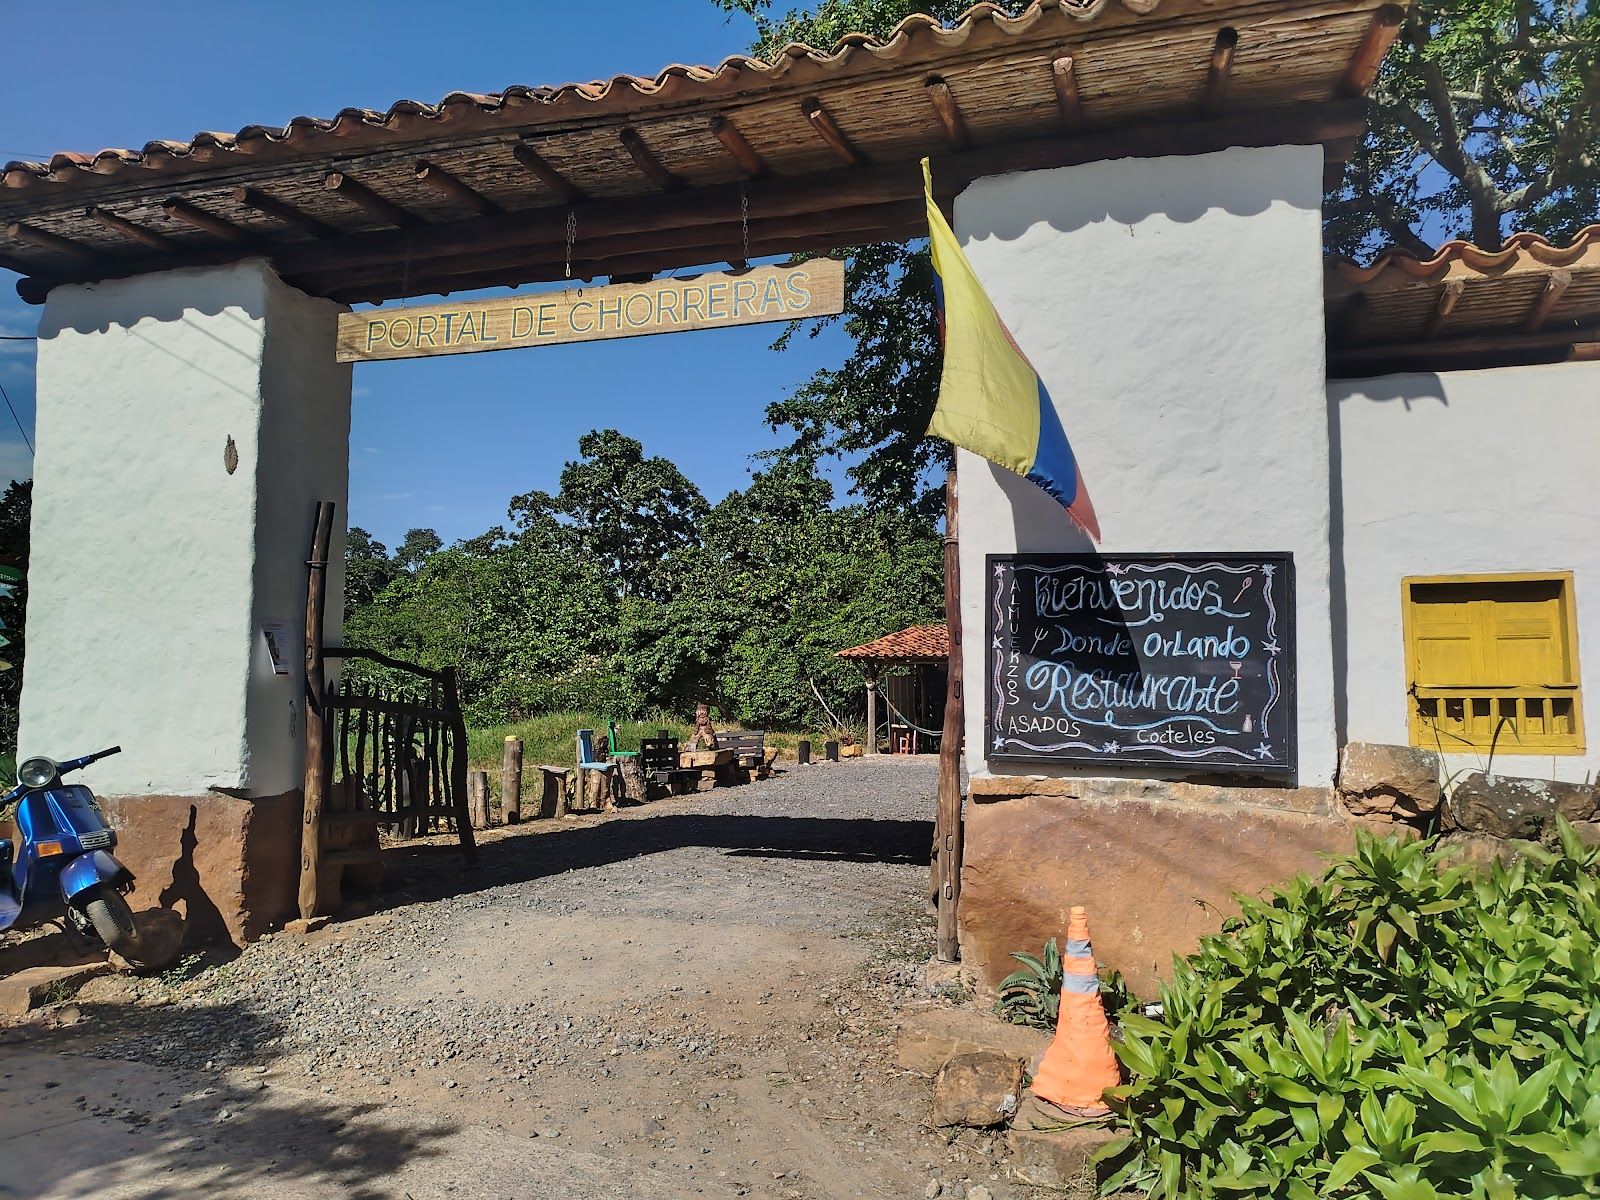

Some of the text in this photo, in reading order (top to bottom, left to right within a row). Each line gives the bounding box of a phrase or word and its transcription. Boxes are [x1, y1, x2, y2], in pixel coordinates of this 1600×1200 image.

[365, 271, 811, 353] PORTAL DE CHORRERAS
[1034, 573, 1251, 627] Bienvenidos
[1006, 577, 1021, 706] ALMUERZOS
[1051, 624, 1132, 656] Donde
[1025, 660, 1240, 716] Restaurante
[1008, 715, 1081, 738] ASADOS
[1136, 724, 1216, 745] Cocteles
